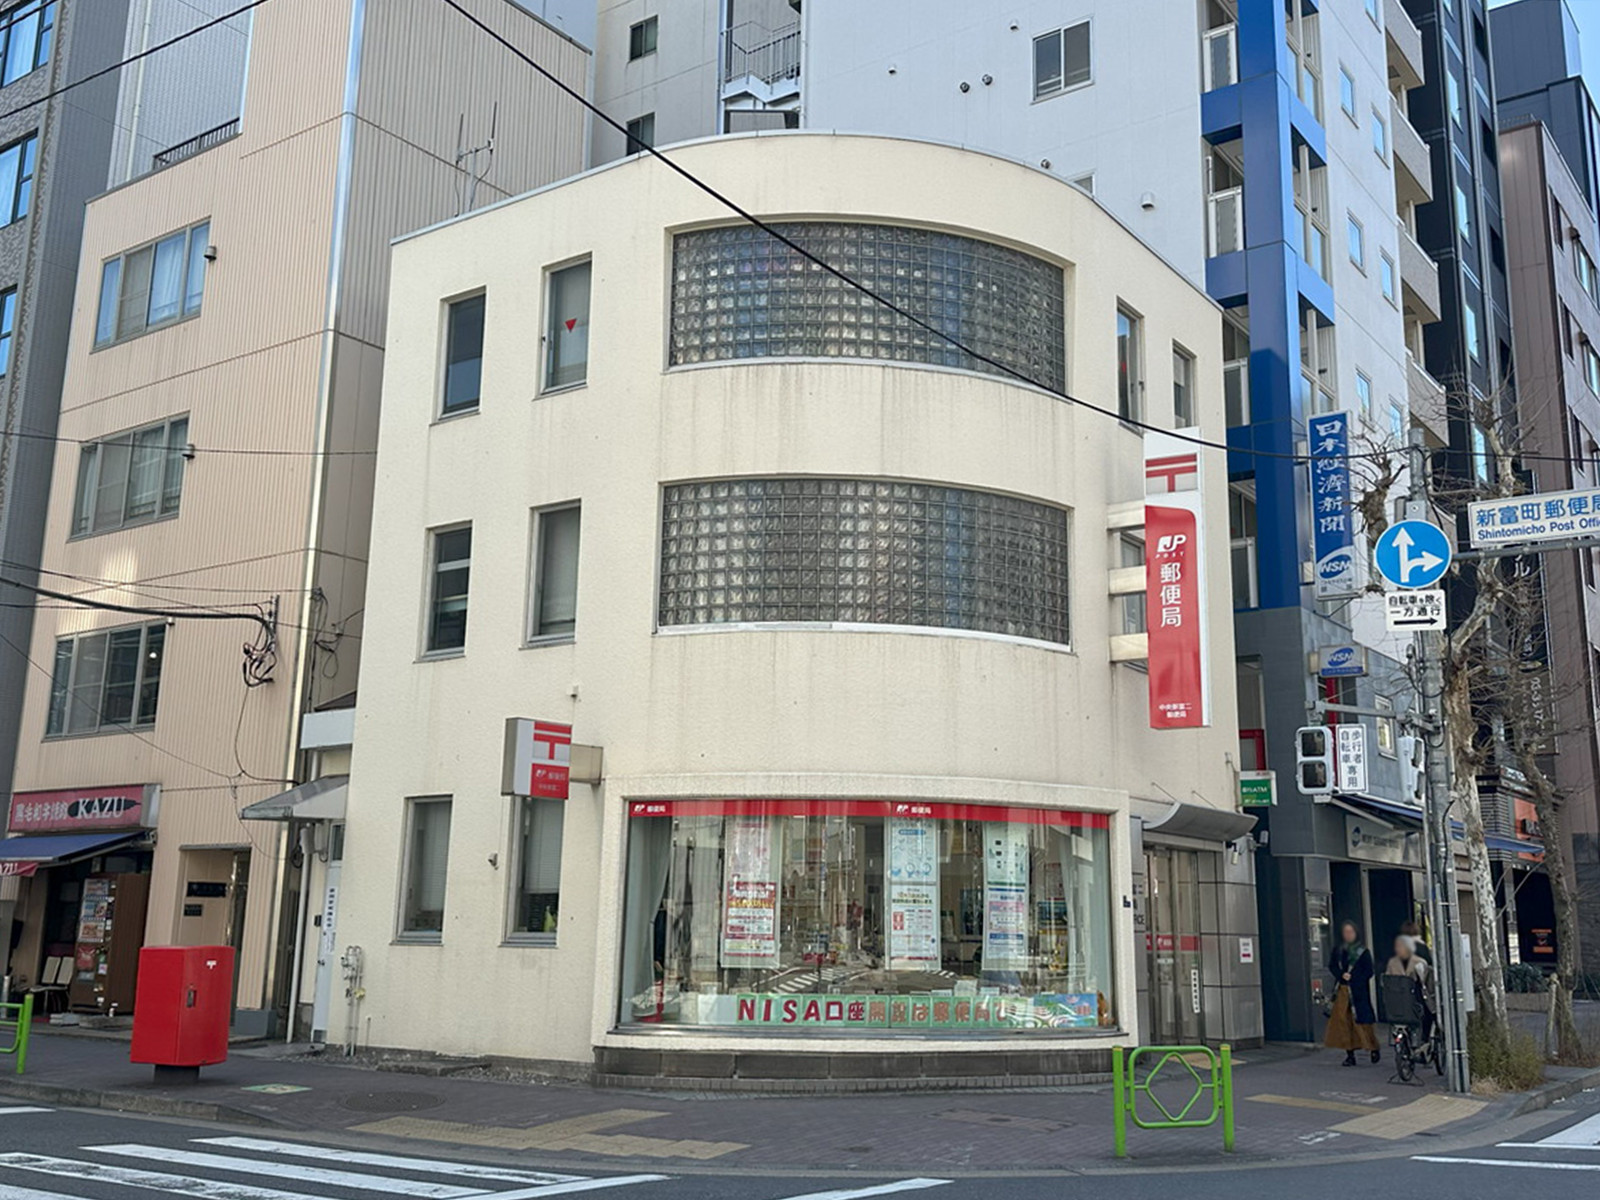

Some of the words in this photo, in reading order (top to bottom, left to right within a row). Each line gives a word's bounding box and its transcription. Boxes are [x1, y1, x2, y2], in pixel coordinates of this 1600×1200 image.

[1478, 524, 1546, 541] Shintomicho
[1549, 520, 1575, 532] Post
[1160, 562, 1182, 628] 郵便局
[1388, 594, 1442, 607] 自転車を除く
[1390, 605, 1441, 617] 一方通行
[1341, 730, 1351, 763] 自転車
[1351, 730, 1362, 764] 歩行者
[1347, 765, 1358, 788] 専用
[76, 797, 126, 820] KAZU
